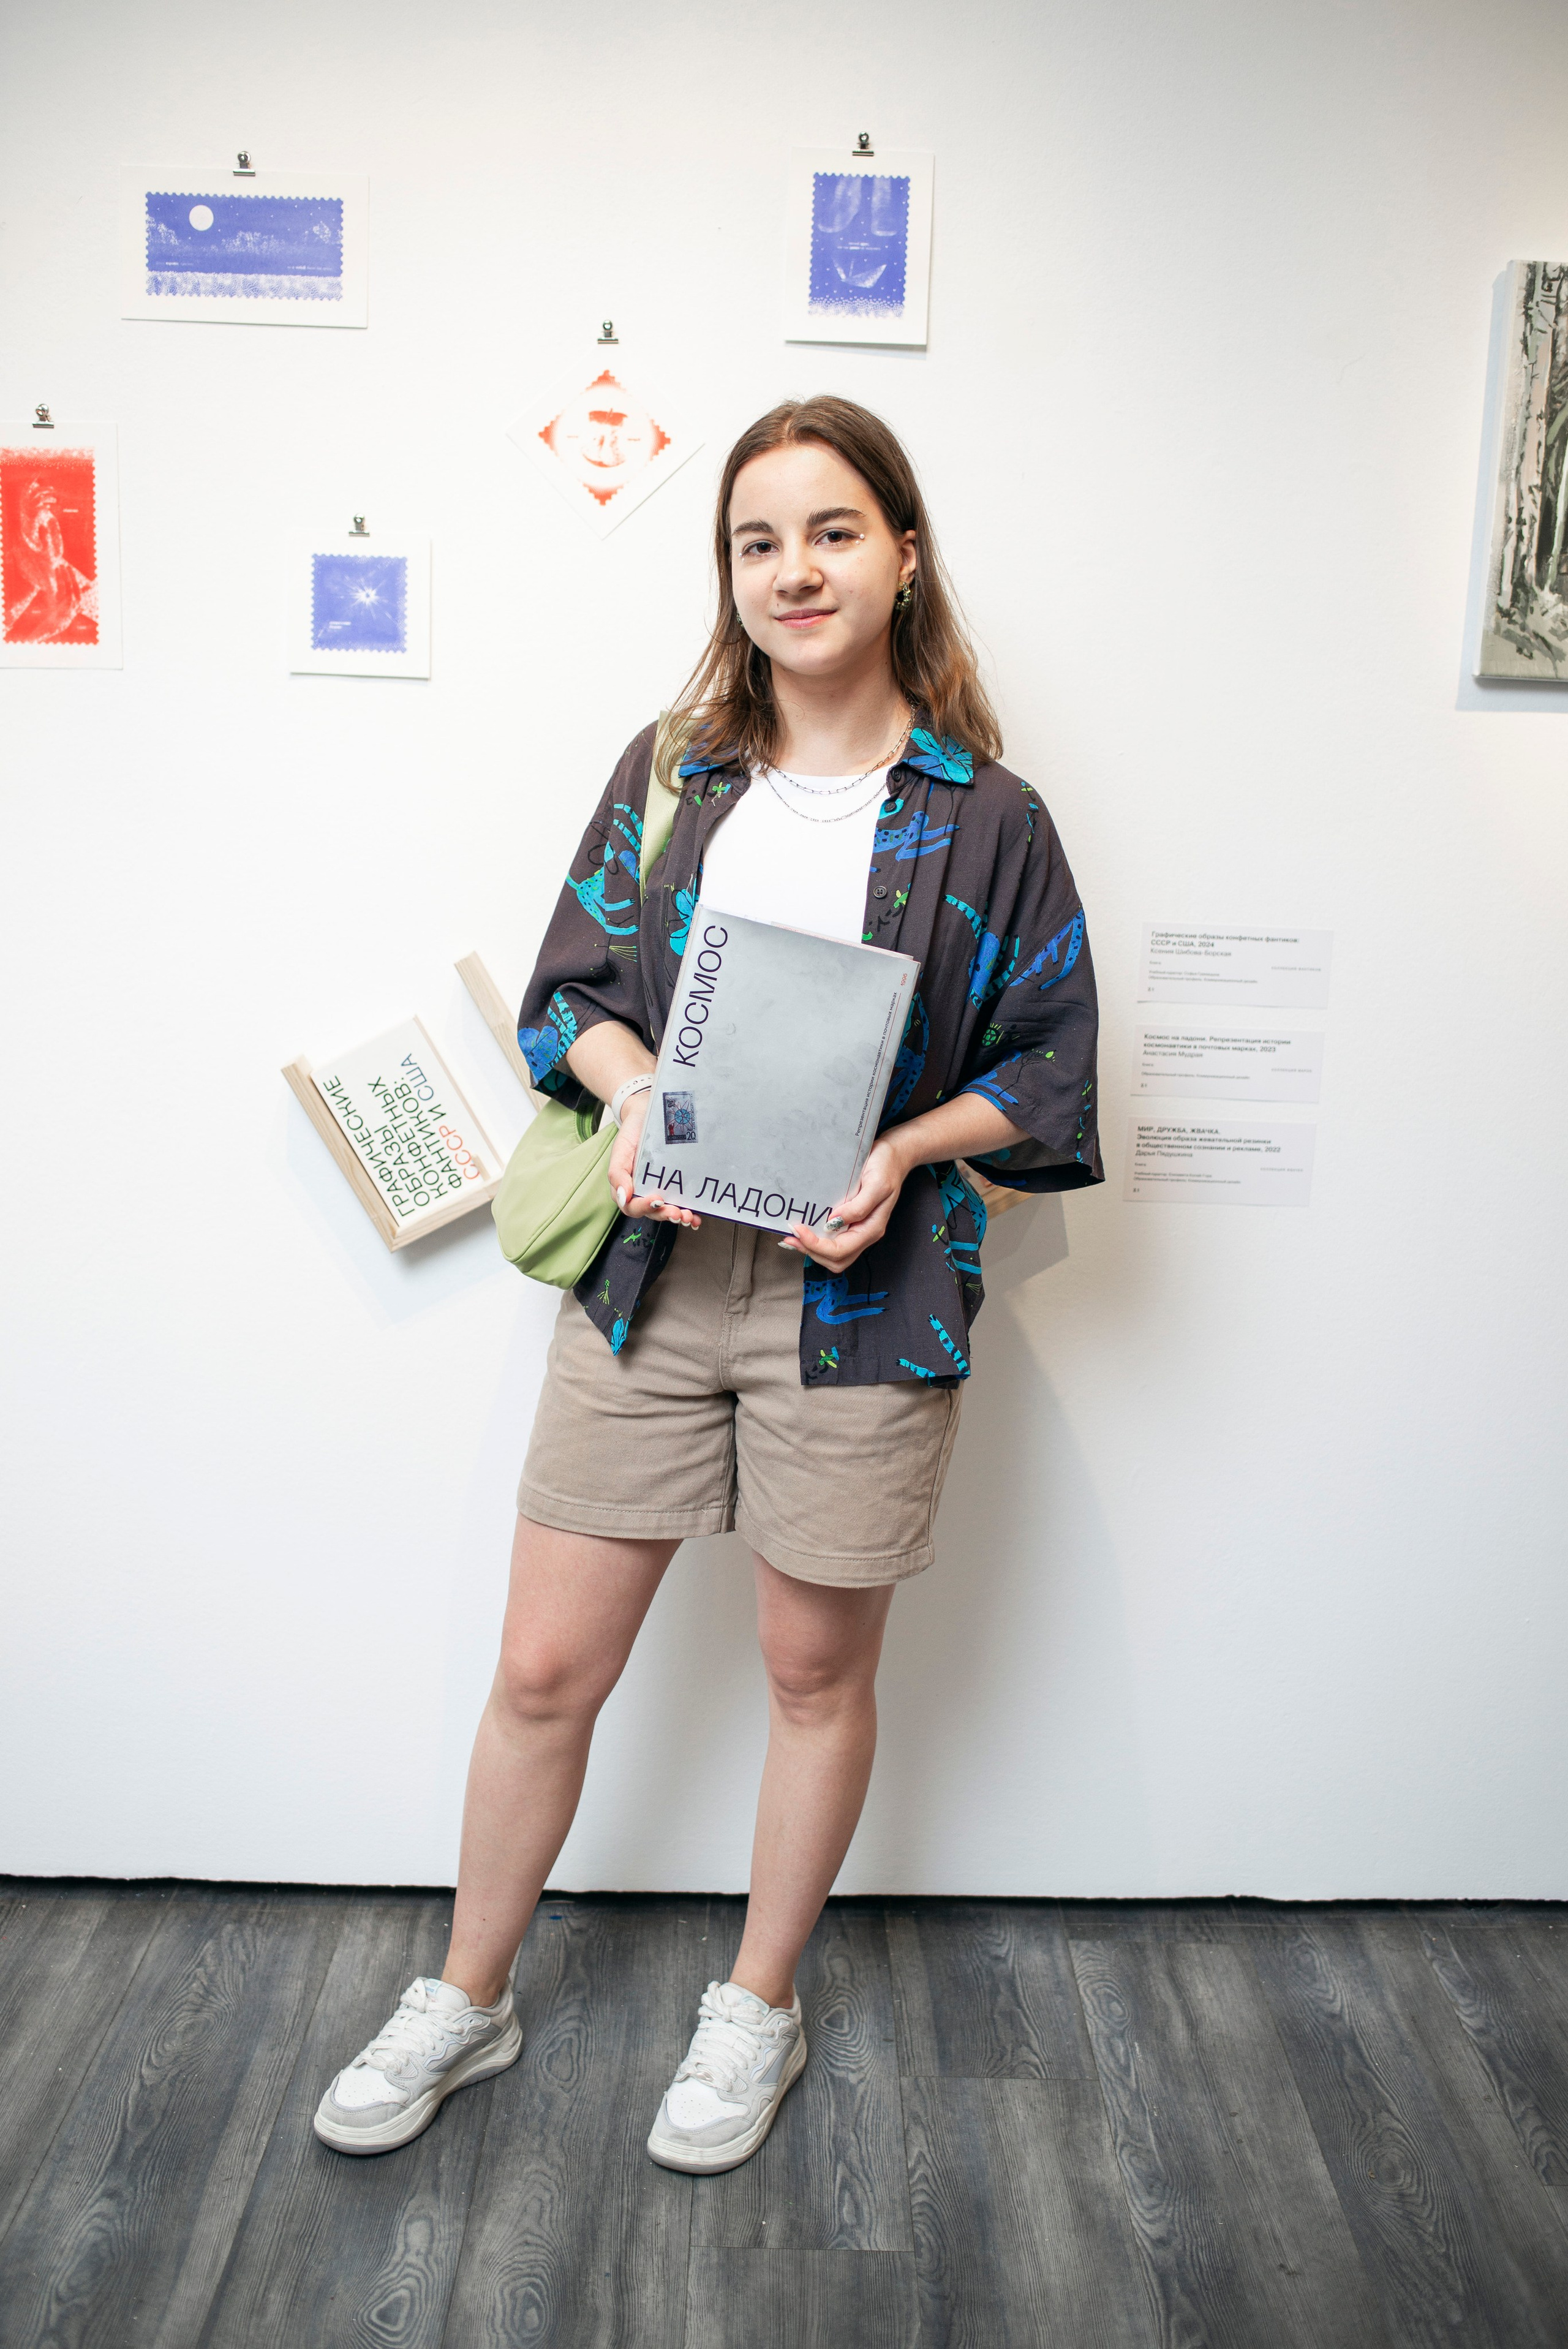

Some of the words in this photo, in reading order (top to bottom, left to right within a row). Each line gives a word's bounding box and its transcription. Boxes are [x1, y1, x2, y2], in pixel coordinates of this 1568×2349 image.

[673, 926, 728, 1067] КОСМОС
[401, 1052, 434, 1101] США
[428, 1103, 447, 1122] И
[854, 1098, 869, 1136] Репрезентация
[866, 1076, 875, 1097] истории
[872, 1039, 884, 1076] космонавтики
[883, 1011, 892, 1035] почтовых
[889, 992, 898, 1011] марках
[323, 1075, 416, 1217] ГРАФИЧЕСКИЕ
[368, 1076, 448, 1199] КОНФЕТНЫХ
[374, 1125, 431, 1207] ОБРАЗЫ
[394, 1077, 462, 1189] ФАНТИКОВ:
[439, 1125, 480, 1180] СССР
[643, 1163, 682, 1194] НА
[696, 1177, 832, 1227] ЛАДОНИ
